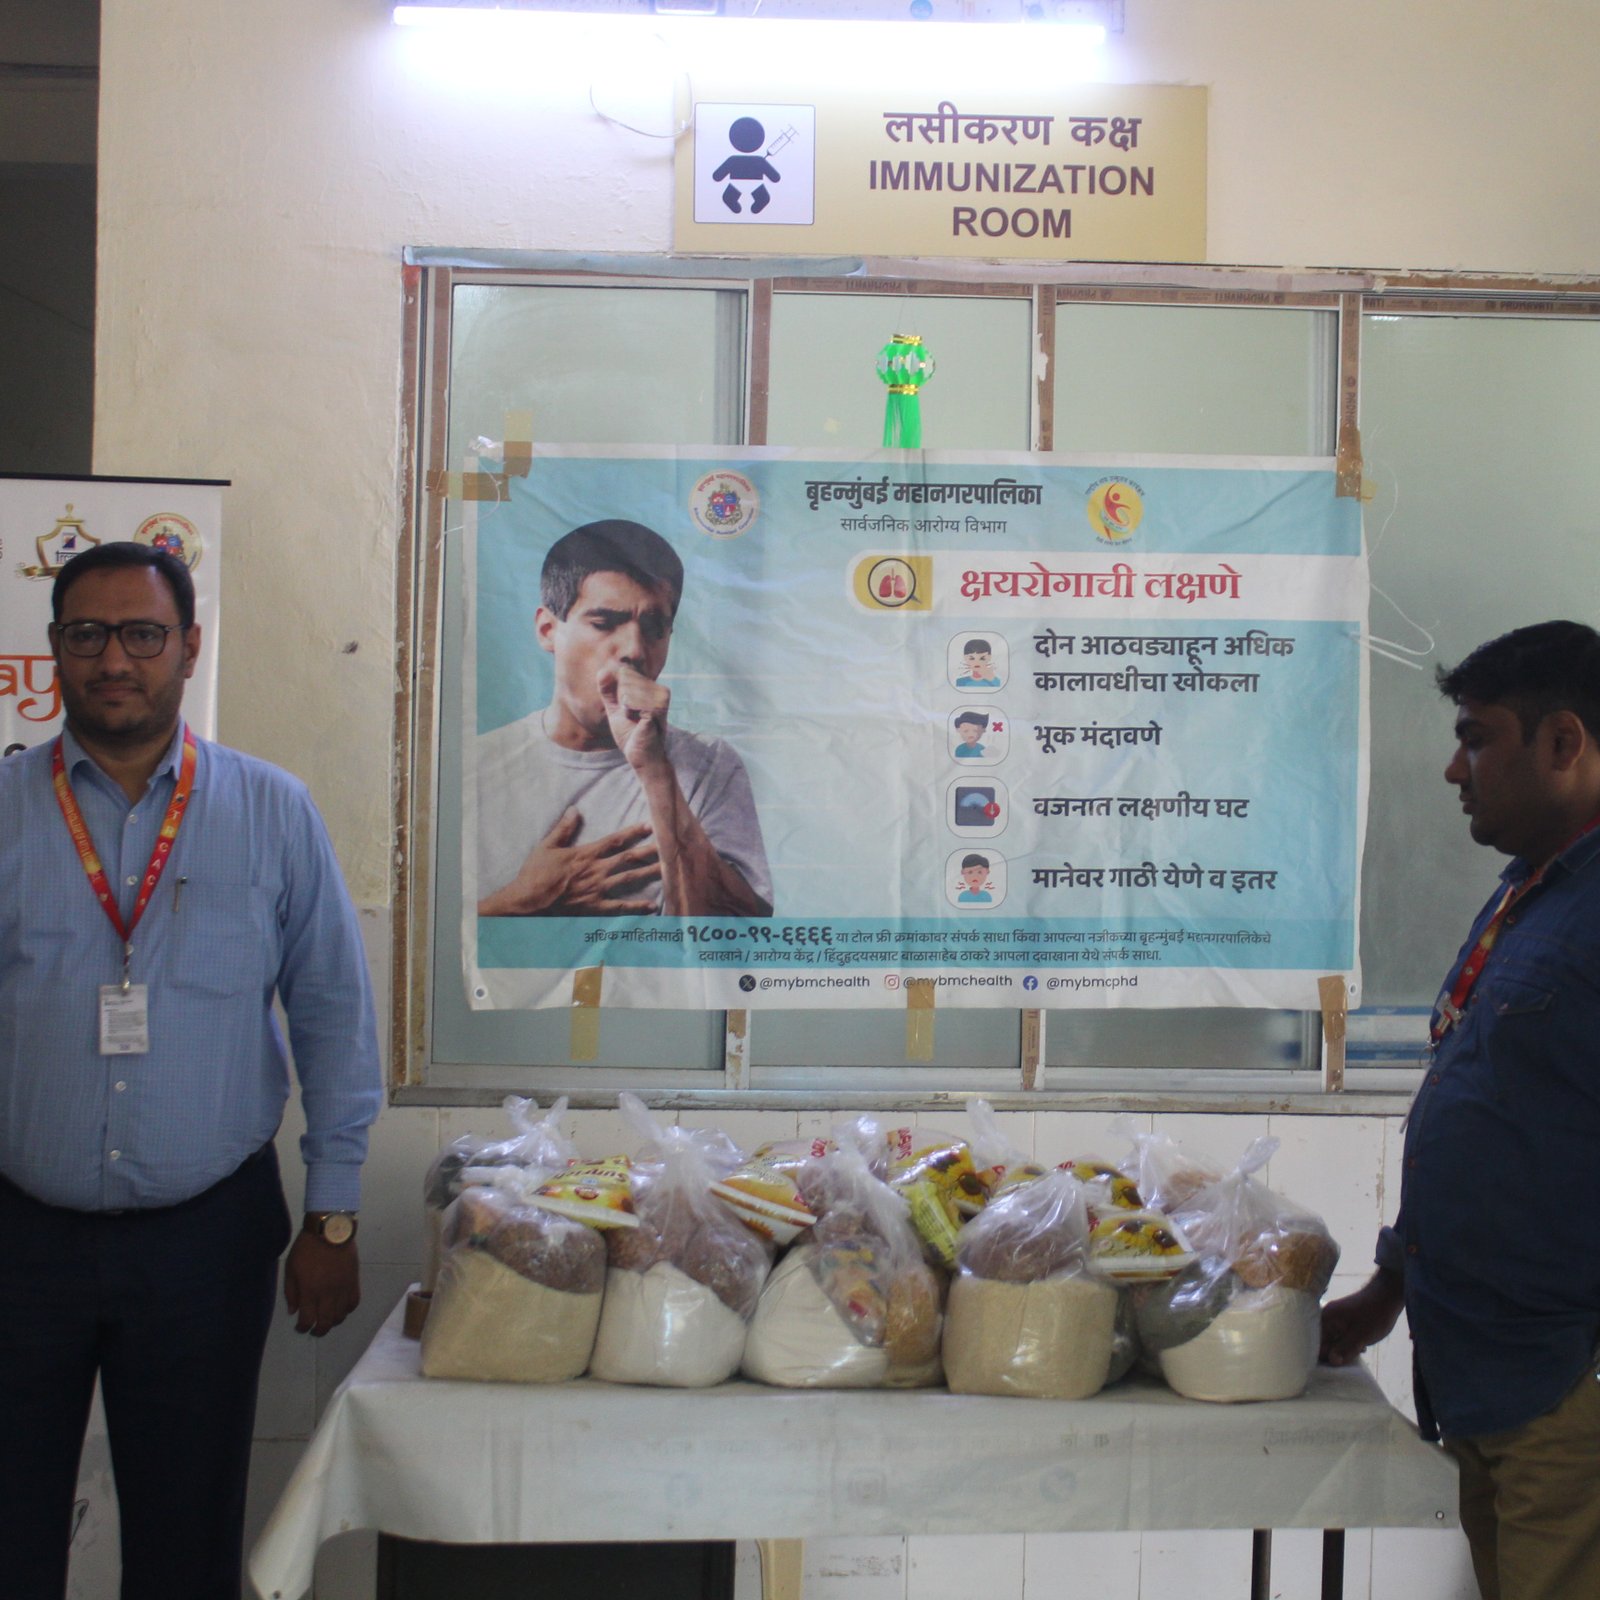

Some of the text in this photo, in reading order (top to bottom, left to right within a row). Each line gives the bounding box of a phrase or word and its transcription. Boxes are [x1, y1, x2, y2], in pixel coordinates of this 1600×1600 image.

[883, 101, 1142, 151] लसीकरण कक्ष
[869, 159, 1155, 196] IMMUNIZATION
[952, 206, 1072, 239] ROOM
[805, 476, 1043, 512] बृहन्मुंबई महानगरपालिका
[840, 514, 1007, 534] सार्वजनिक आरोग्य विभाग
[960, 562, 1243, 603] क्षयरोगाची लक्षणे
[1034, 629, 1295, 665] दोन आठवड्याहून अधिक
[1034, 665, 1260, 693] कालावधीचा खोकला
[1034, 720, 1162, 753] भूक मंदावणे
[1033, 791, 1250, 820] वजनात लक्षणीय घट
[1032, 861, 1278, 894] मानेवर गाठी येणे व इतर
[584, 928, 618, 943] अधिक
[620, 927, 683, 943] माहितीसाठी
[836, 932, 848, 943] या
[851, 929, 873, 943] टोल
[1012, 929, 1040, 943] किंवा
[1044, 932, 1084, 943] आपल्या
[1088, 929, 1135, 943] नजीकच्या
[753, 950, 790, 962] आरोग्य
[961, 948, 990, 961] ठाकरे
[993, 950, 1029, 961] आपला
[1033, 950, 1079, 962] दवाखाना
[1082, 948, 1099, 961] येथे
[760, 975, 870, 991] @mybmchealth
[1046, 975, 1138, 991] @mybmcphd
